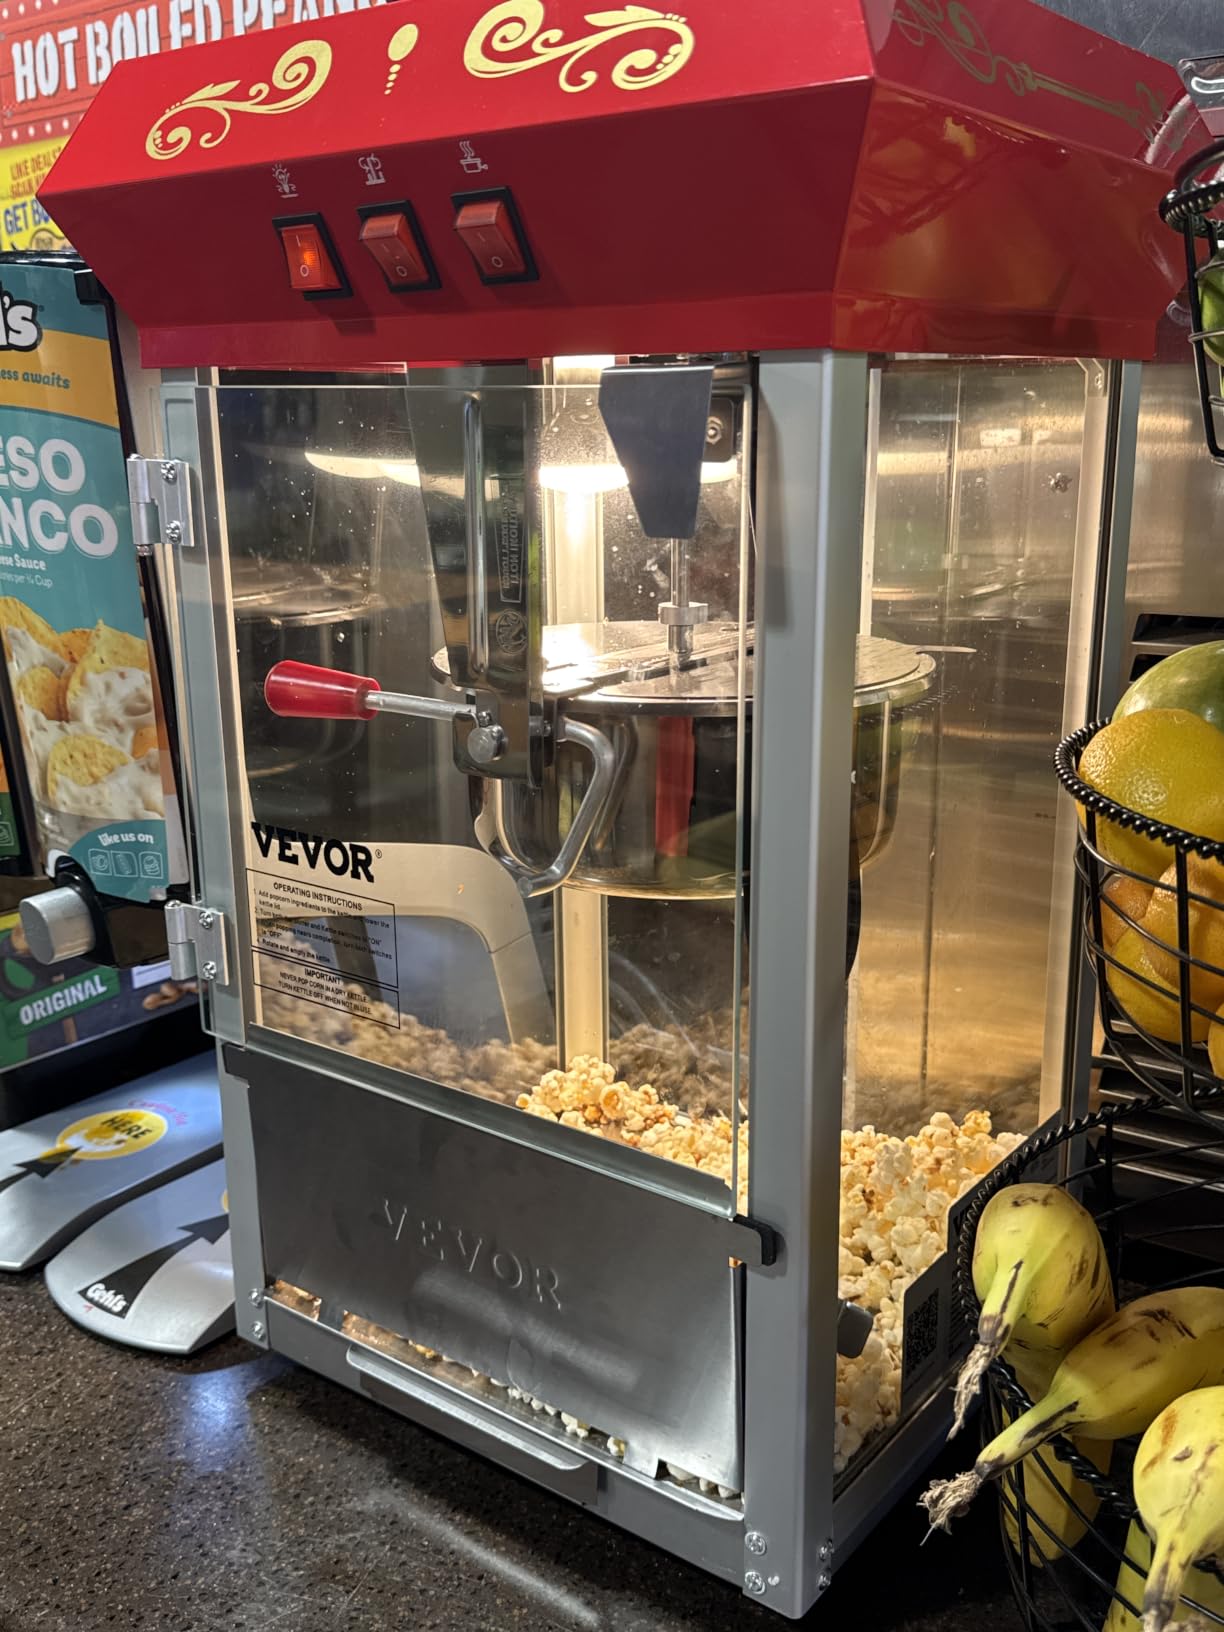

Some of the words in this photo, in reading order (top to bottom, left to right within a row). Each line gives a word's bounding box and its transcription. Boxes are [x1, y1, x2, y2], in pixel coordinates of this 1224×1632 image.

[11, 26, 79, 103] HOT
[4, 201, 29, 235] GET
[22, 371, 71, 390] awaits
[14, 553, 47, 571] Sauce
[120, 833, 136, 842] us
[137, 833, 154, 845] on
[273, 881, 311, 898] OPERATING
[311, 891, 362, 910] INSTRUCTIONS
[290, 897, 320, 912] ingredients
[380, 920, 389, 928] the
[279, 942, 289, 951] and
[305, 950, 315, 958] the
[304, 967, 340, 985] IMPORTANT
[309, 979, 323, 990] CORN
[20, 975, 107, 1026] ORIGINAL
[292, 984, 312, 997] KETTLE
[323, 993, 341, 1005] WHEN
[101, 1115, 153, 1141] HERE
[384, 1199, 562, 1312] VEVOR
